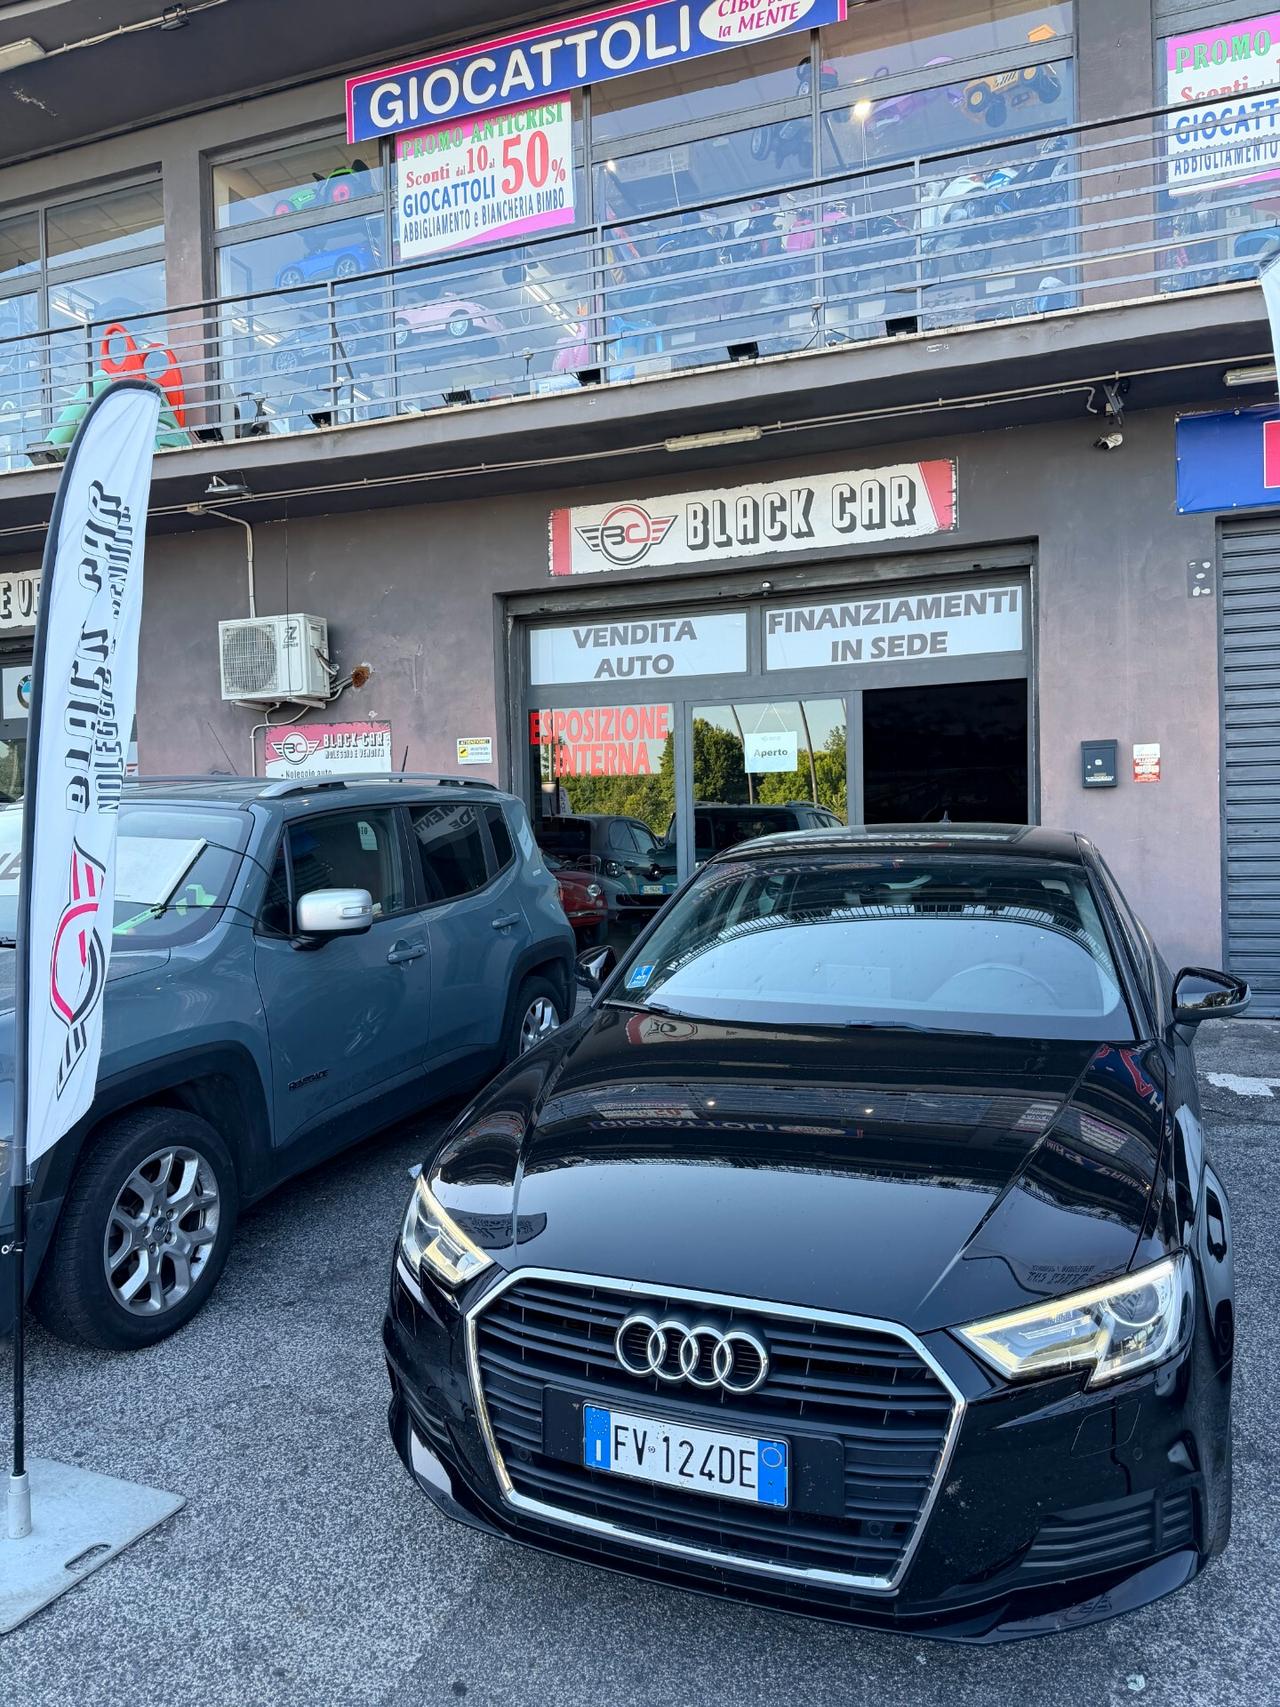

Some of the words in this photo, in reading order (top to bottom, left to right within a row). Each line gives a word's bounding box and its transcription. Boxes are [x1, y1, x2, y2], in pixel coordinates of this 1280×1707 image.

[718, 25, 732, 38] la
[738, 1, 800, 33] MENTE
[369, 5, 690, 128] GIOCATTOLI
[1175, 30, 1271, 74] PROMO
[402, 127, 464, 161] PROMO
[470, 103, 564, 144] ANTICRISI
[406, 163, 450, 188] Sconti
[466, 144, 488, 174] 10
[403, 175, 496, 218] GIOCATTOLI
[403, 208, 471, 243] ABBIGLIAMENTO
[481, 194, 534, 226] BIANCHERIA
[536, 187, 565, 213] BIMBO
[686, 487, 815, 551] BLACK
[831, 475, 916, 533] CAR
[768, 589, 1019, 635] FINANZIAMENTI
[572, 620, 698, 649] VENDITA
[831, 638, 863, 662] IN
[870, 631, 949, 659] SEDE
[593, 653, 675, 679] AUTO
[322, 733, 359, 749] BLACK
[362, 731, 385, 747] CAR
[528, 705, 669, 745] ESPOSIZIONE
[555, 742, 651, 777] INTERNA
[753, 748, 789, 759] Aperto
[614, 1424, 648, 1466] FV
[662, 1435, 756, 1489] 124DE
